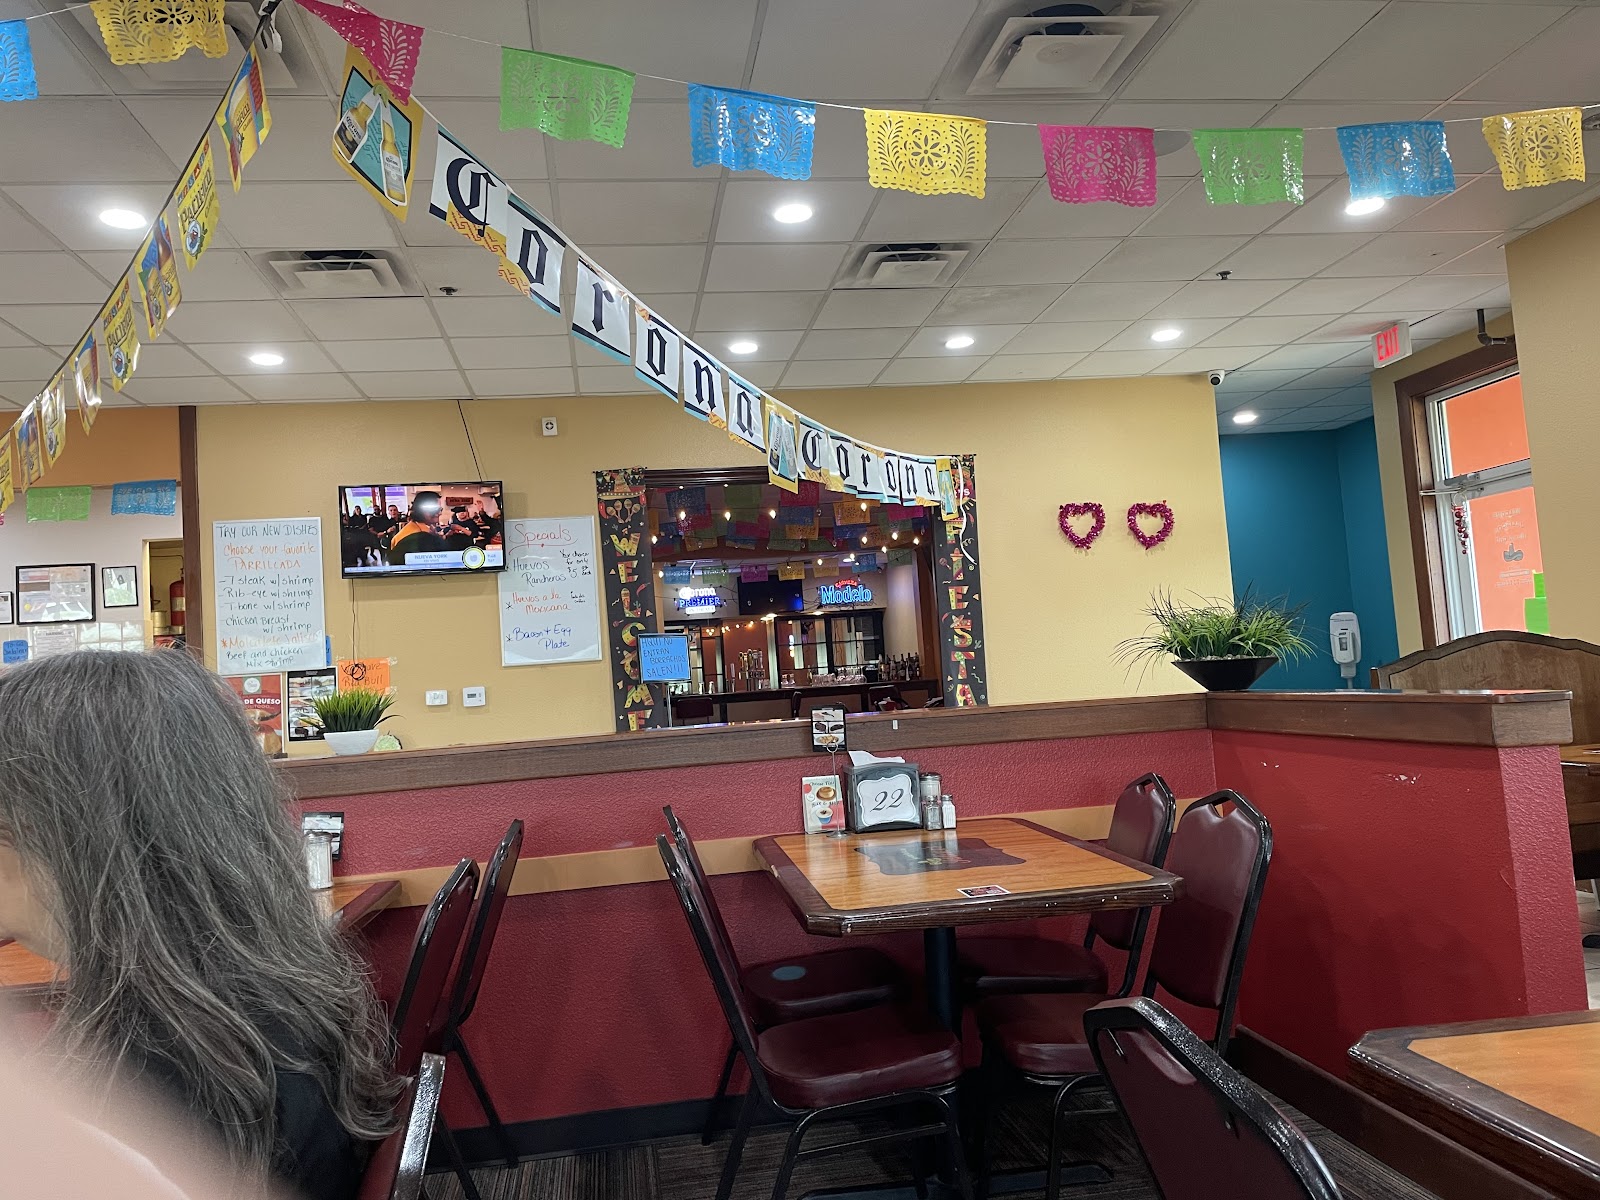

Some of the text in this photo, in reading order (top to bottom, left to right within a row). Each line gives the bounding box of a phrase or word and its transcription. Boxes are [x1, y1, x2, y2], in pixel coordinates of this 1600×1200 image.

[446, 157, 754, 438] Corona
[1376, 325, 1400, 362] EXIT
[802, 429, 936, 496] Corona
[216, 523, 319, 538] TRY OUR NEW DISHES
[509, 523, 572, 548] Specials
[224, 541, 316, 557] Choose your favorite
[513, 558, 550, 572] Huevos
[238, 574, 266, 585] steak
[521, 572, 567, 587] Rancheros
[512, 592, 540, 605] Huevos
[679, 586, 716, 599] Corona
[820, 584, 872, 604] Modelo
[525, 603, 571, 615] Mexicana
[680, 597, 721, 608] PREMIER
[226, 614, 290, 627] Chicken Breast
[277, 622, 312, 632] shrimp
[513, 627, 544, 641] Bacon
[554, 624, 572, 637] Egg
[538, 638, 570, 650] Plate
[226, 647, 304, 661] Beef and chicken
[643, 648, 670, 658] ENTRAN
[255, 697, 281, 705] QUESO
[870, 788, 906, 812] 22
